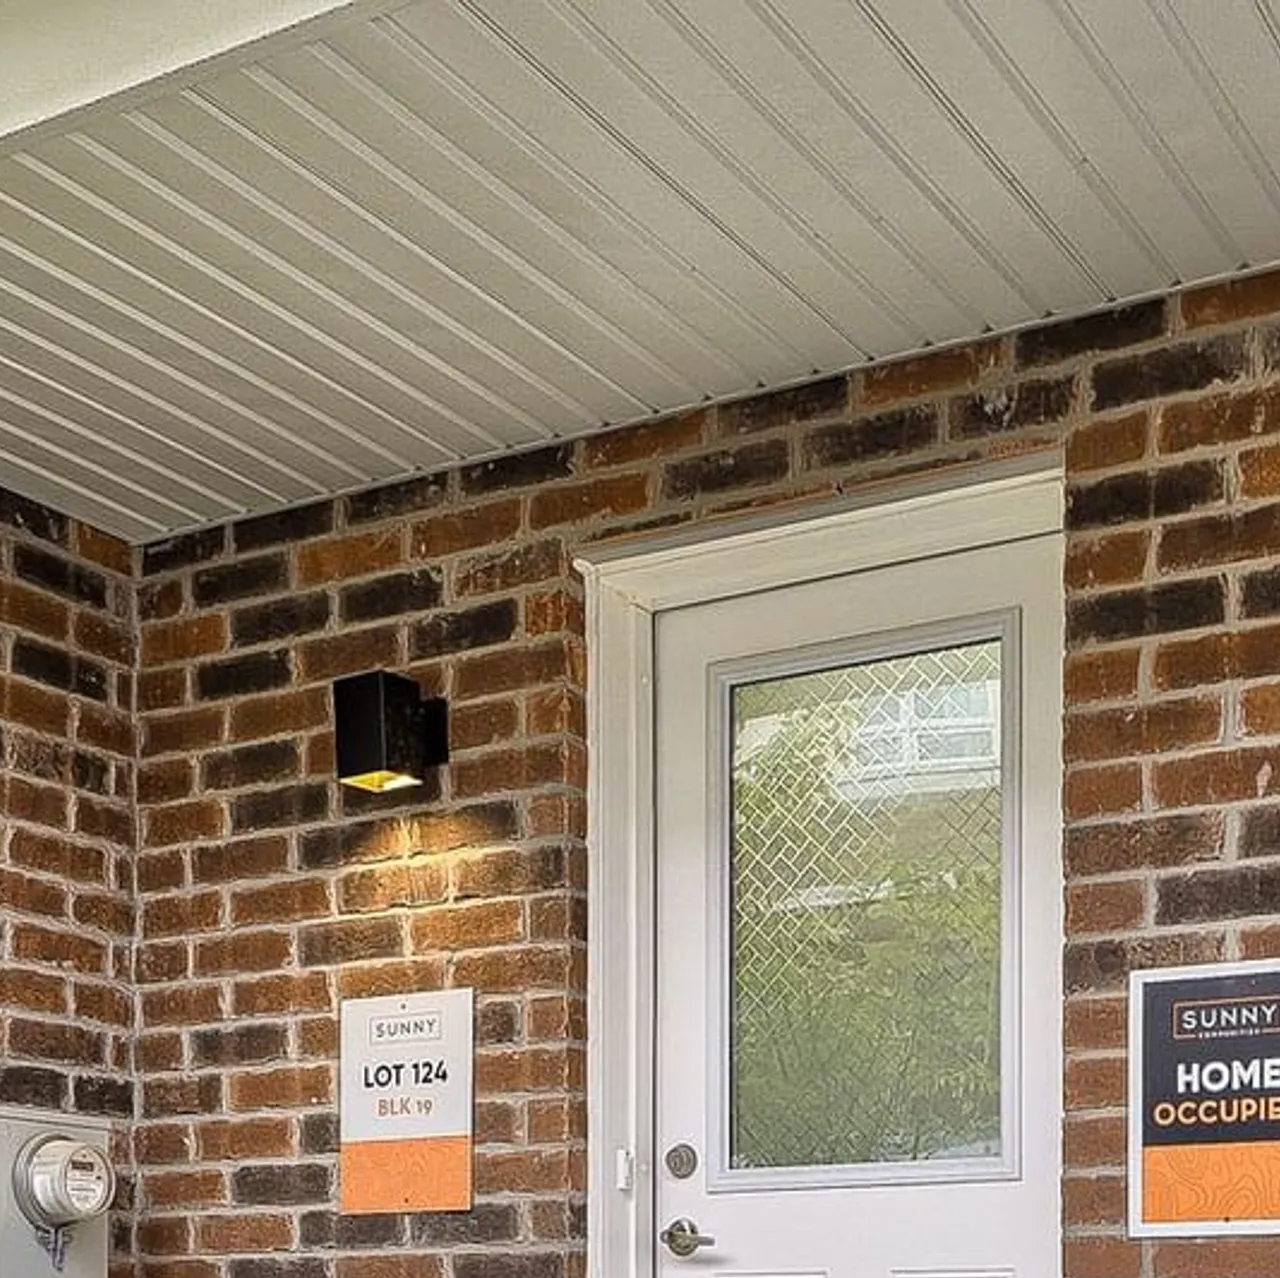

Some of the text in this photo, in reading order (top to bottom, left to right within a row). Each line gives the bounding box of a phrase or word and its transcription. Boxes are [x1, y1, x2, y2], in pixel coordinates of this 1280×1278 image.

[375, 1018, 438, 1039] SUNNY
[1181, 1003, 1278, 1030] SUNNY
[363, 1060, 448, 1089] LOT 124
[377, 1097, 433, 1117] BLK 19
